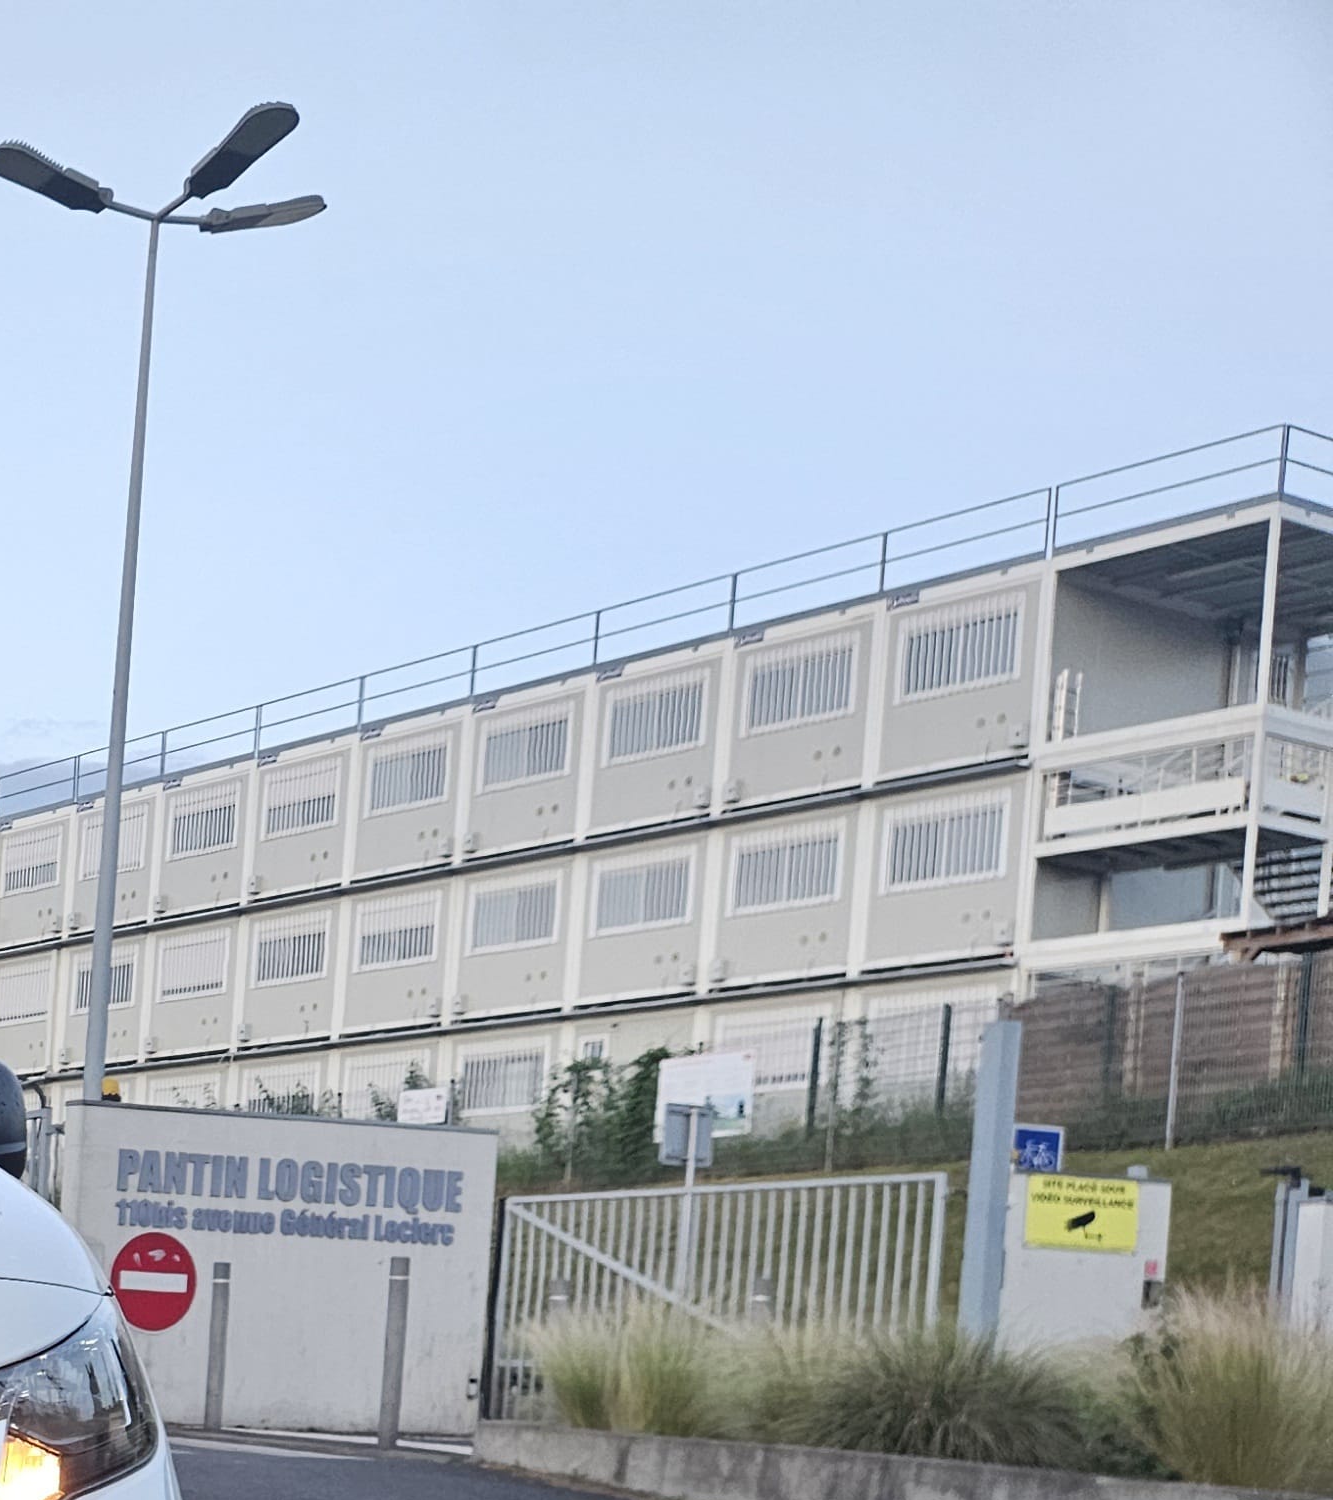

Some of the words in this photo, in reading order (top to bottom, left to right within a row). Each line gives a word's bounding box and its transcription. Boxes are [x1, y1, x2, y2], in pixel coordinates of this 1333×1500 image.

[117, 1148, 249, 1199] PANTIN
[257, 1157, 465, 1215] LOGISTIQUE
[191, 1207, 276, 1235] avenue
[280, 1207, 371, 1241] Général
[373, 1214, 456, 1247] Leclerc
